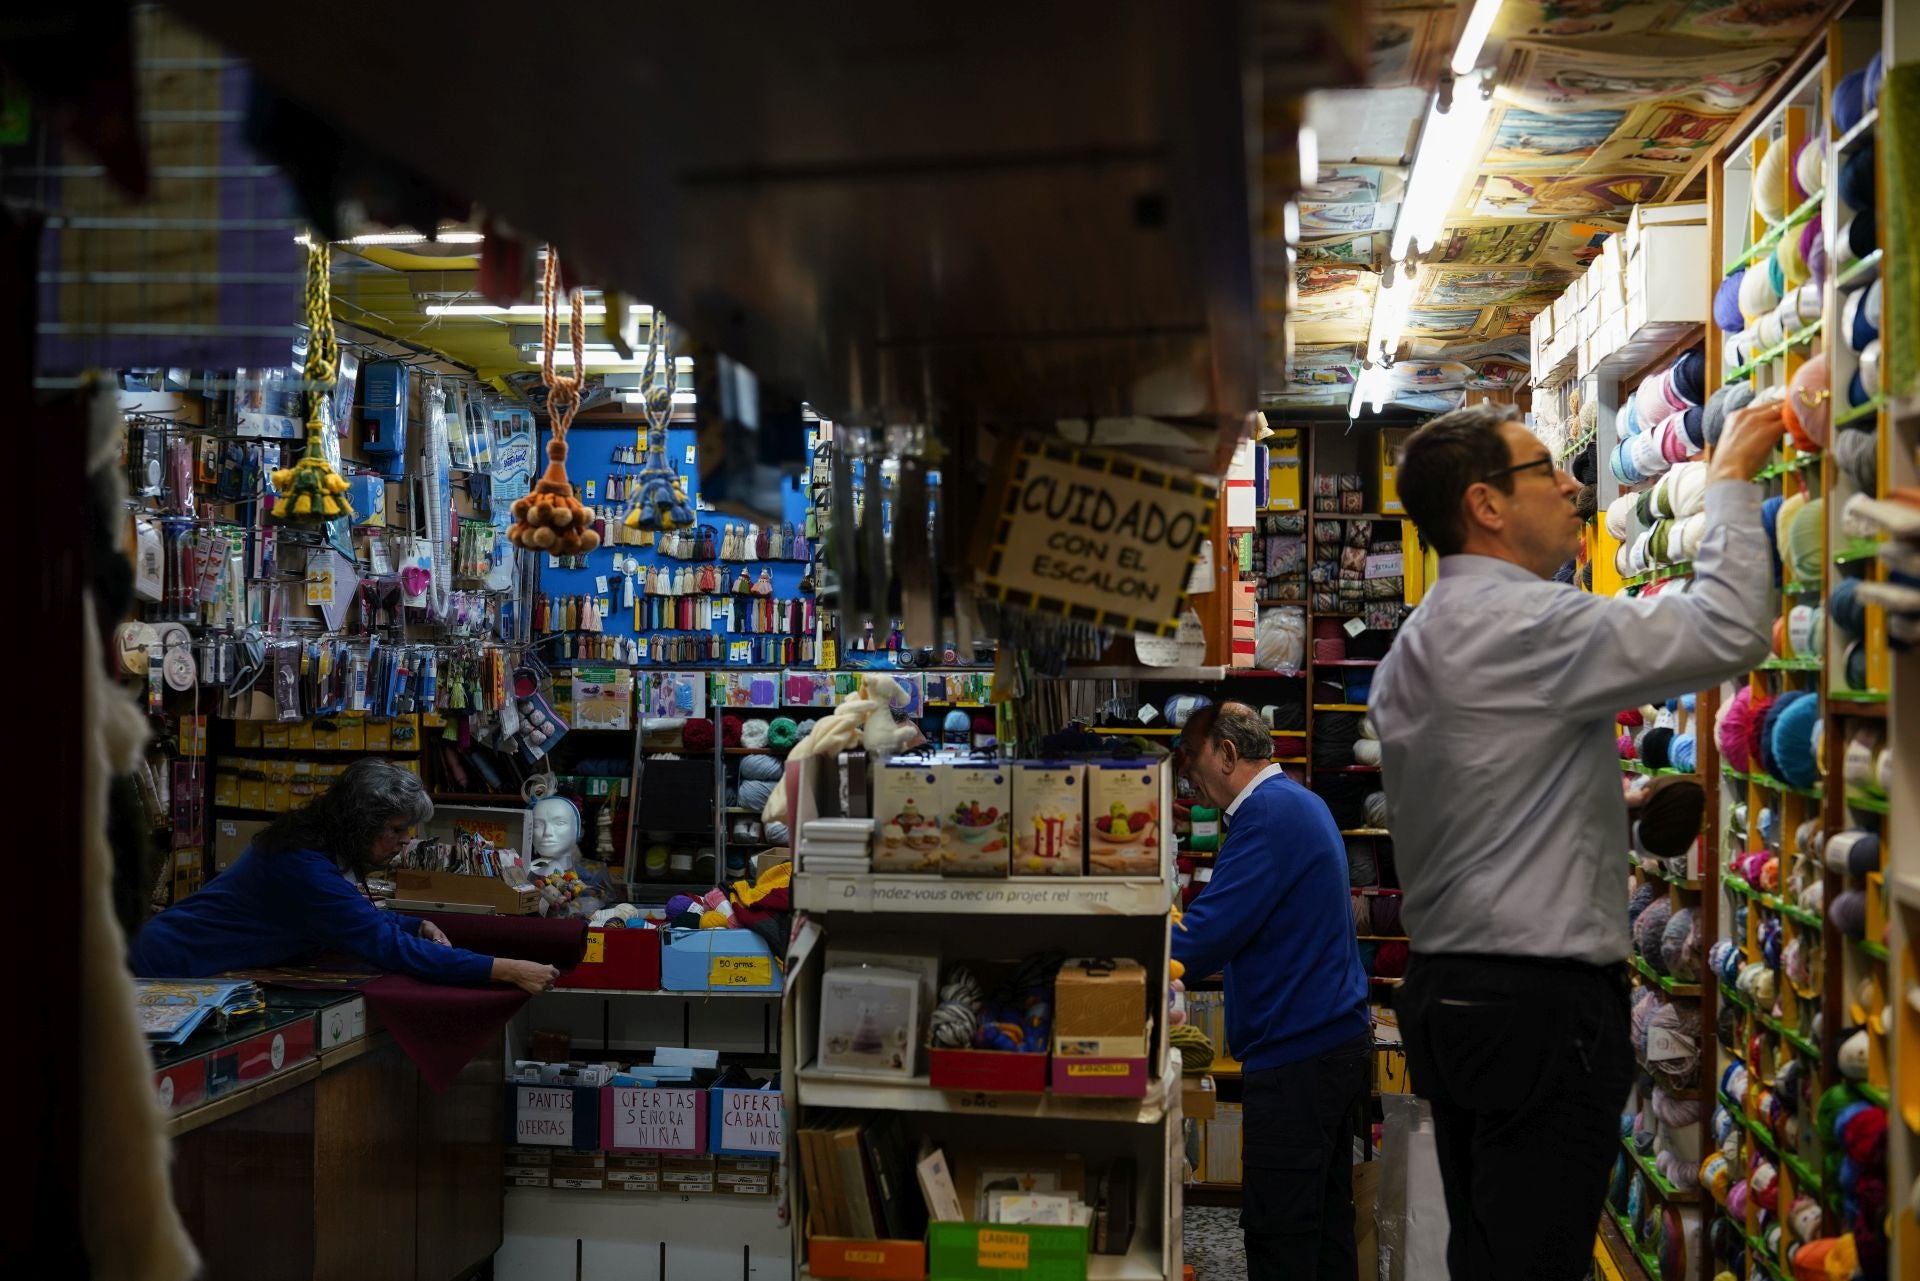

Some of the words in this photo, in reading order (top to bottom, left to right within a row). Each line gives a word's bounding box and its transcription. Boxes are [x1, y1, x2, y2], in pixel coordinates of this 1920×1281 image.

[1021, 475, 1196, 550] CUIDADO
[1047, 531, 1109, 561] CON
[1117, 547, 1147, 572] EL
[950, 890, 982, 902] avec
[986, 891, 1004, 902] un
[1007, 889, 1048, 906] projet
[1051, 889, 1109, 903] relant
[719, 960, 731, 968] 50
[528, 1091, 572, 1110] PANTIS
[621, 1091, 695, 1109] OFERTAS
[733, 1093, 781, 1111] OFERT
[518, 1120, 565, 1136] OFERTAS
[724, 1111, 780, 1128] CABALL
[638, 1126, 681, 1146] NIÑA
